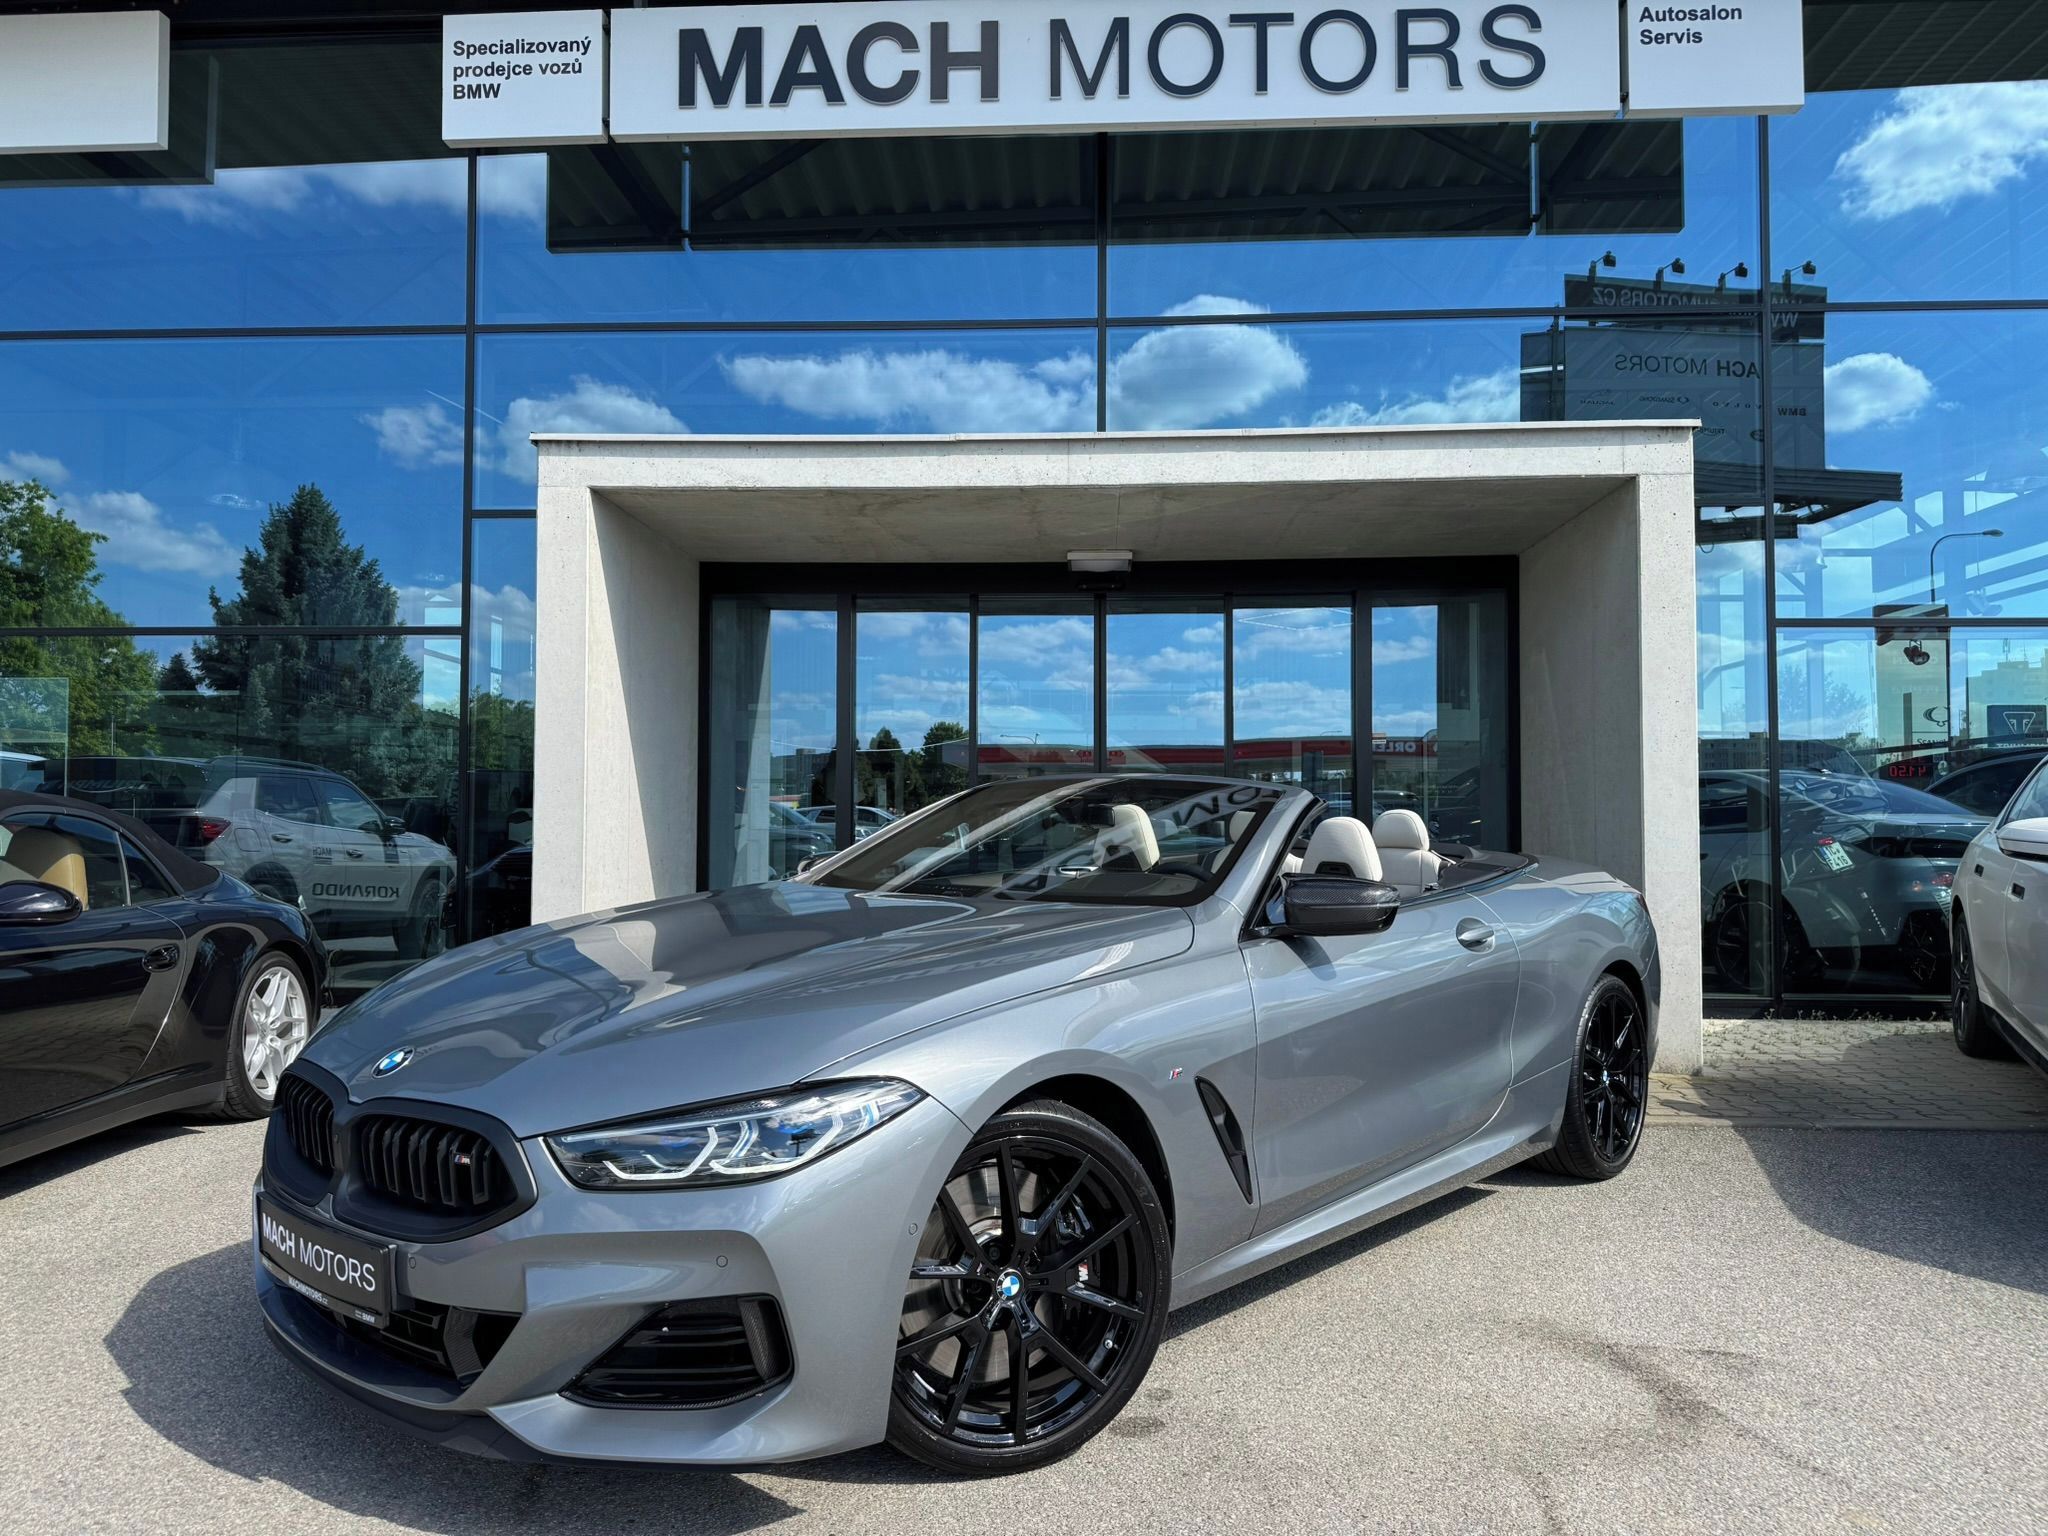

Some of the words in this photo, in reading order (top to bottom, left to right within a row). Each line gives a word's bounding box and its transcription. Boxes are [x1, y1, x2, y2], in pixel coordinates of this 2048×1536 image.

[1639, 5, 1743, 23] Autosalon
[453, 36, 592, 60] Specializovaný
[1640, 28, 1703, 45] Servis
[678, 20, 1000, 109] MACH
[1049, 3, 1547, 100] MOTORS
[453, 61, 533, 81] prodejce
[538, 58, 582, 75] vozů
[453, 83, 501, 100] BMW
[262, 1212, 296, 1259] MACH
[300, 1237, 376, 1291] MOTORS
